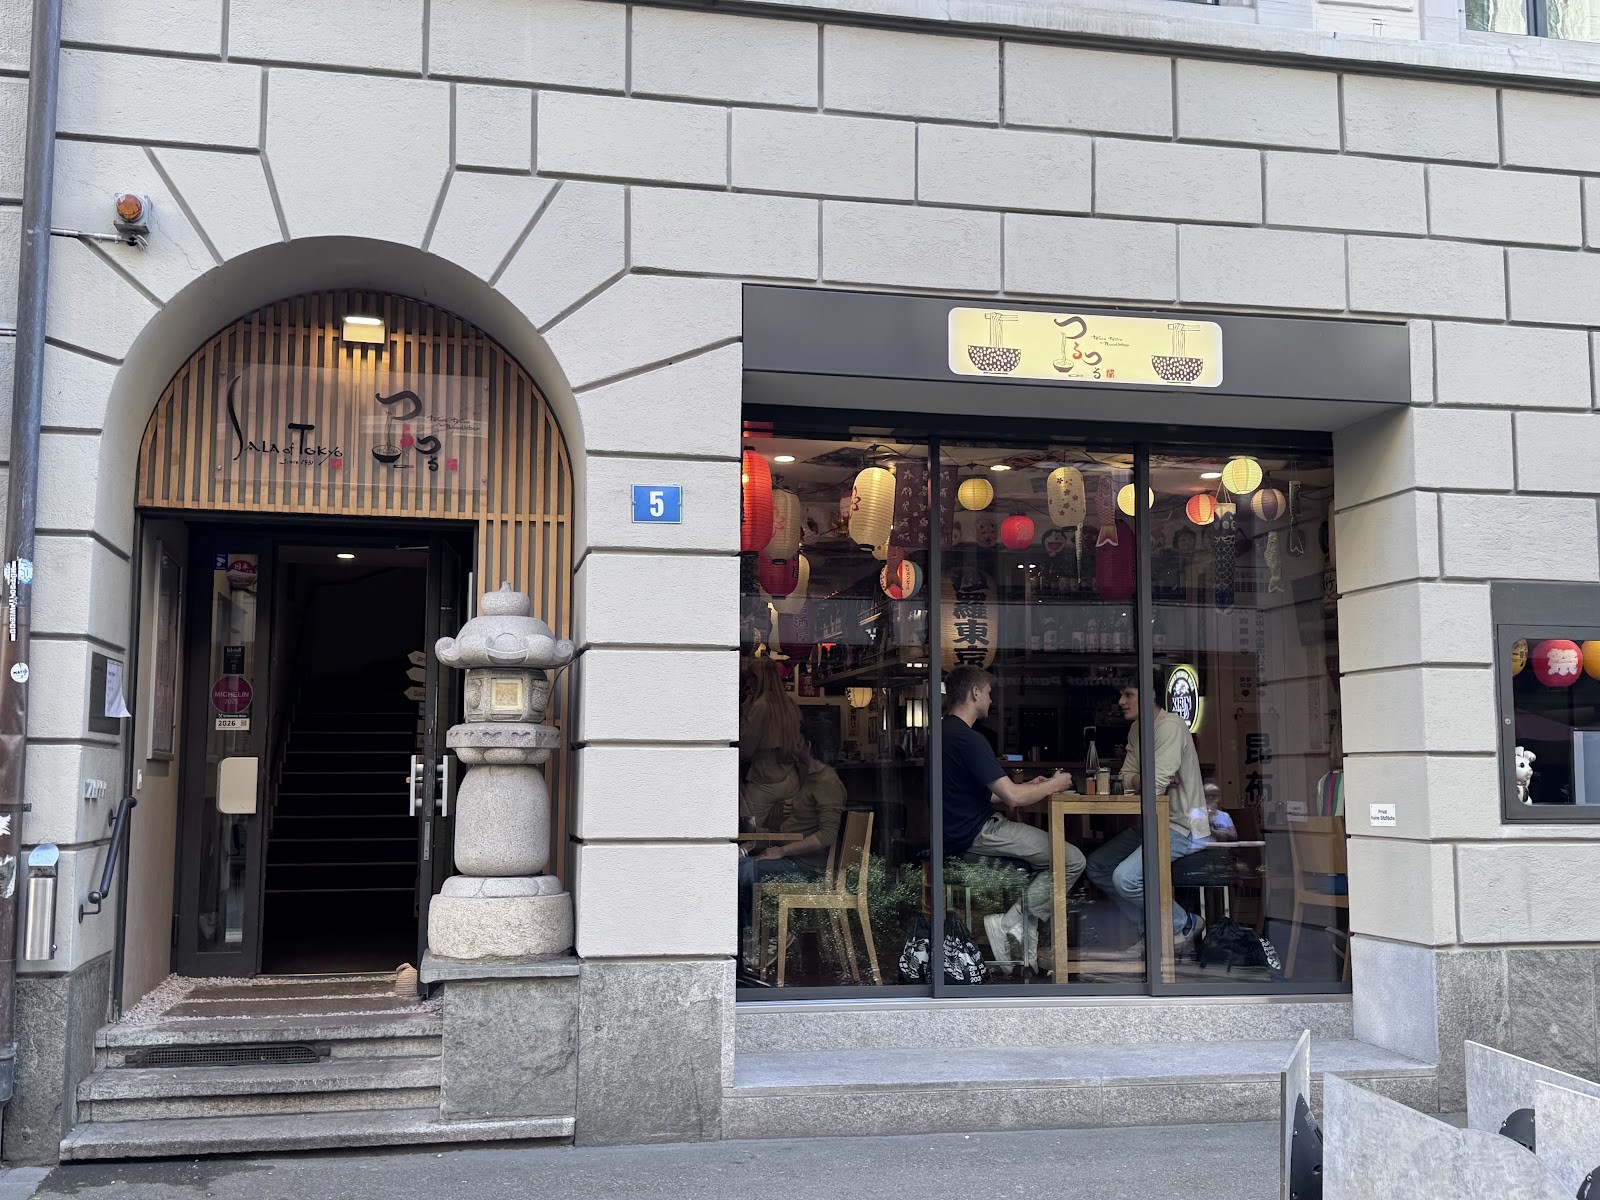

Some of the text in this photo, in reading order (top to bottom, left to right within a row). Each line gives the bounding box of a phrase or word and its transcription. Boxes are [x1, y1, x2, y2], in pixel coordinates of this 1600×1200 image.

[282, 442, 295, 456] of
[650, 490, 664, 517] 5
[1547, 648, 1579, 676] 祭
[1172, 696, 1192, 711] KIRIN
[1245, 733, 1273, 802] 昆布
